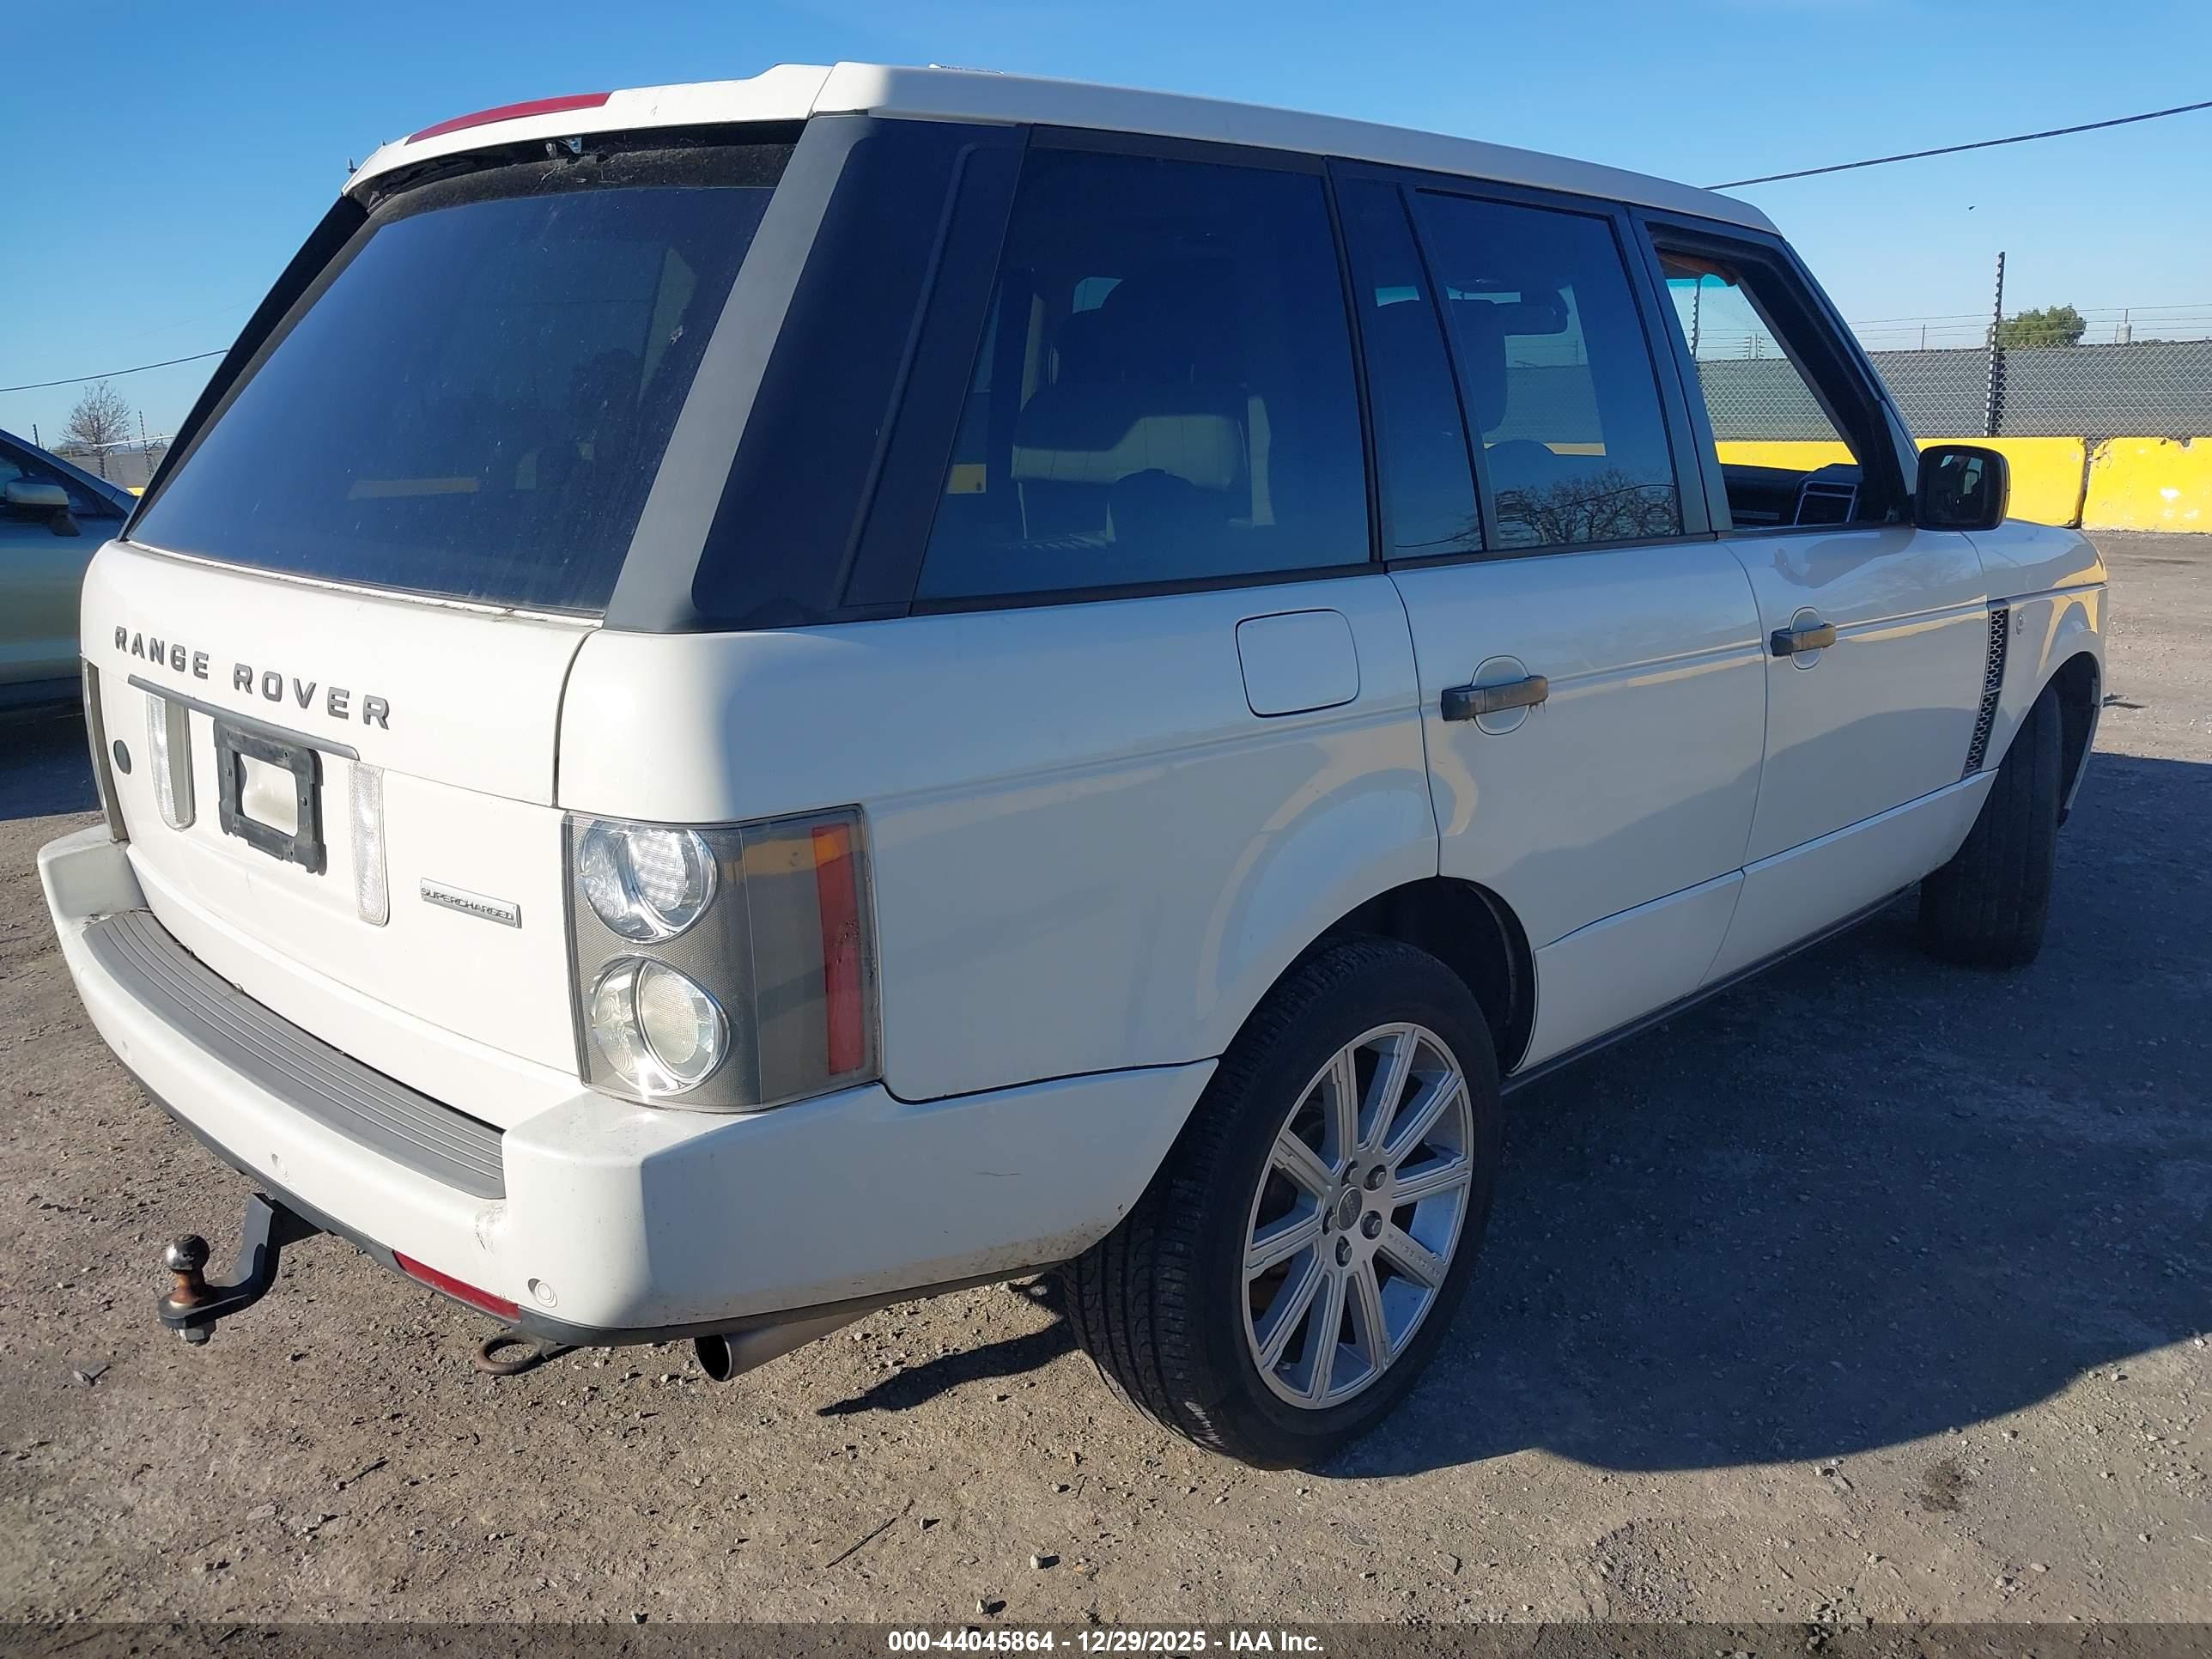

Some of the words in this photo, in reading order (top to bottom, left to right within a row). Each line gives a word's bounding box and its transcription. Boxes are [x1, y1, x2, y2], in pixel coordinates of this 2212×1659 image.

[115, 625, 210, 680] RANGE
[233, 663, 391, 730] ROVER
[420, 886, 515, 922] SUPERCHARGED
